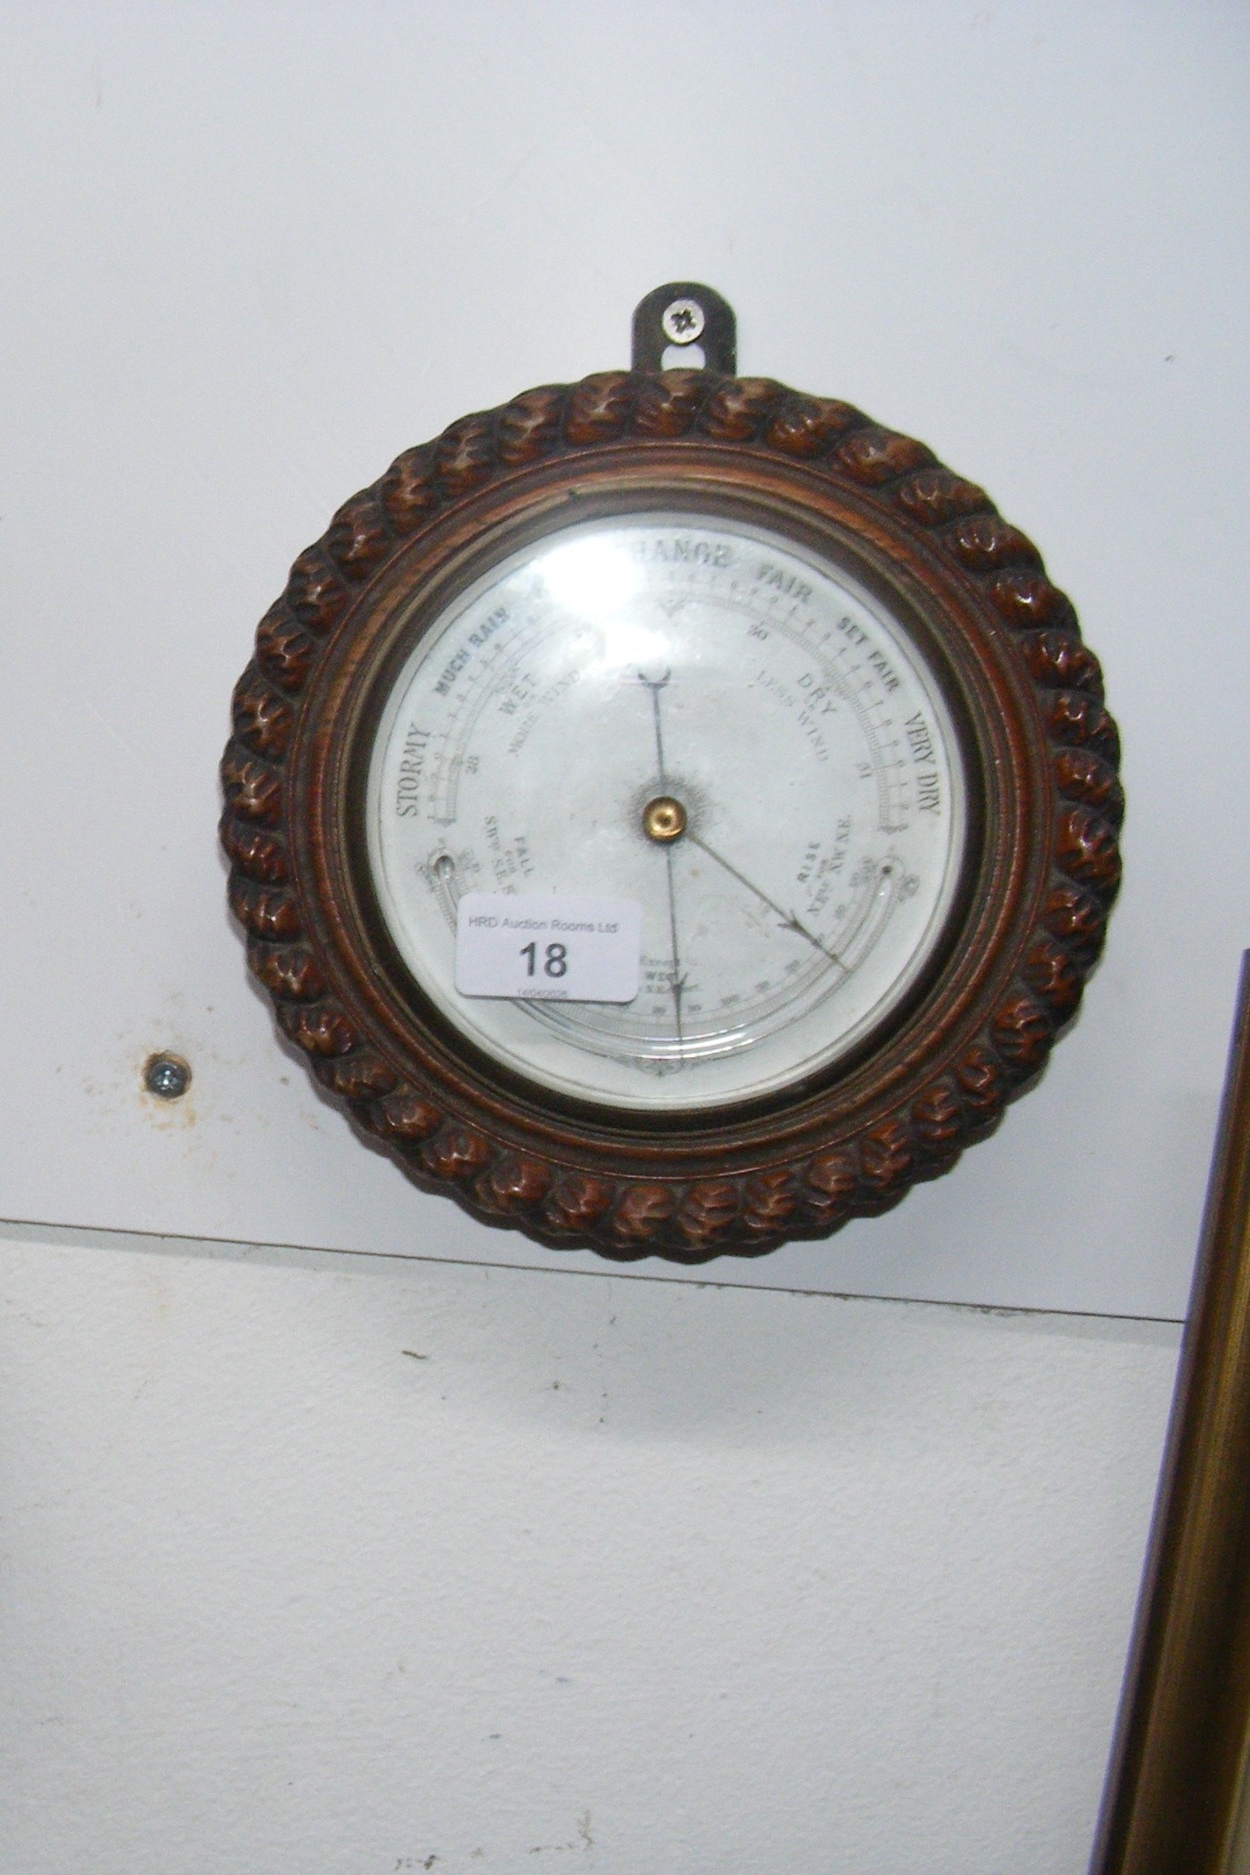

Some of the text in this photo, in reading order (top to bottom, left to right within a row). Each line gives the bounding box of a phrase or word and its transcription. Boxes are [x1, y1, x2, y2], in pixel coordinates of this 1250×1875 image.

[755, 562, 813, 603] FAIR
[434, 649, 471, 696] MUCH
[837, 616, 900, 692] SET FAIR
[499, 673, 536, 716] WET
[798, 672, 837, 716] DRY
[798, 711, 829, 762] WIND
[396, 722, 431, 817] STORMY
[904, 710, 940, 816] VERY DRY
[469, 916, 619, 934] HRD Auction Rooms Ltd
[519, 941, 568, 979] 18
